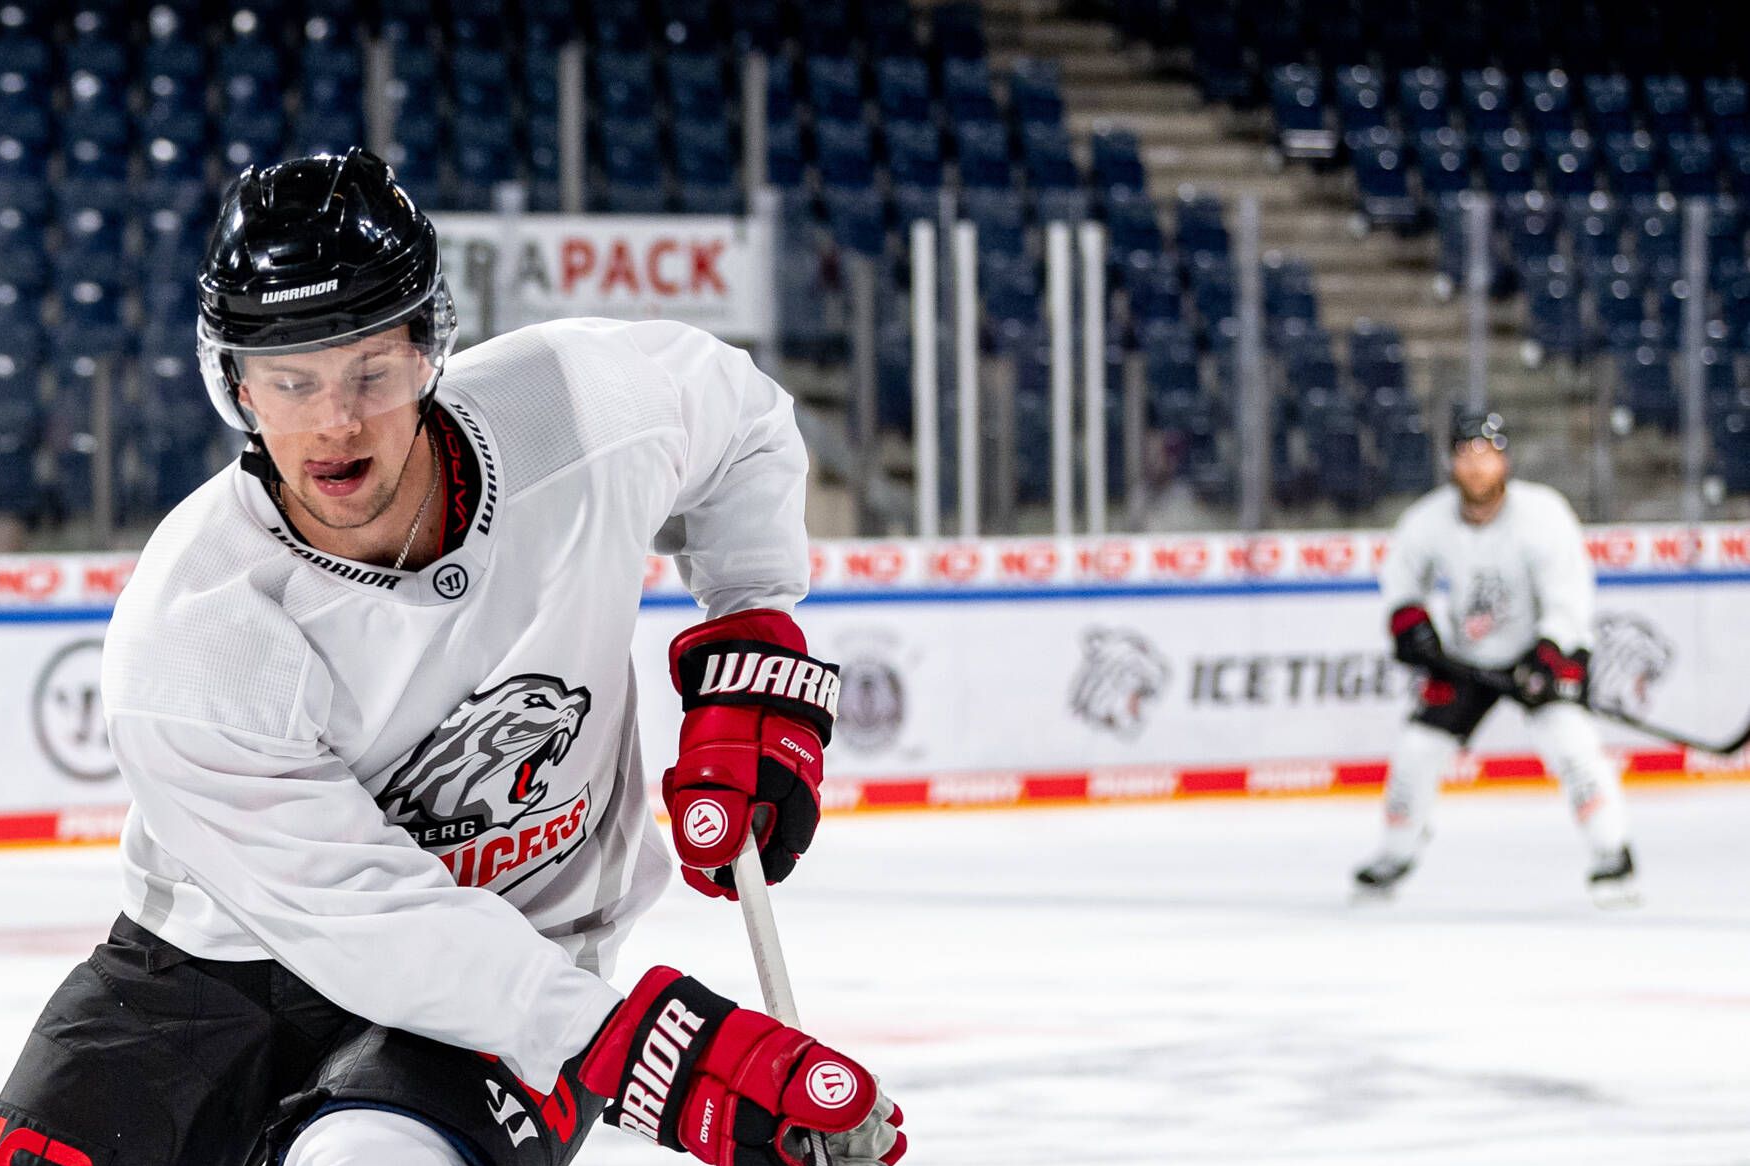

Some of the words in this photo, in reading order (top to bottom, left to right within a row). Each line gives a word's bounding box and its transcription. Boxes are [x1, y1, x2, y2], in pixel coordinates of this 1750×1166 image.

[440, 237, 729, 297] RAPACK
[261, 279, 338, 304] WARRIOR
[780, 737, 815, 763] COVERT
[699, 1098, 716, 1143] COVERT
